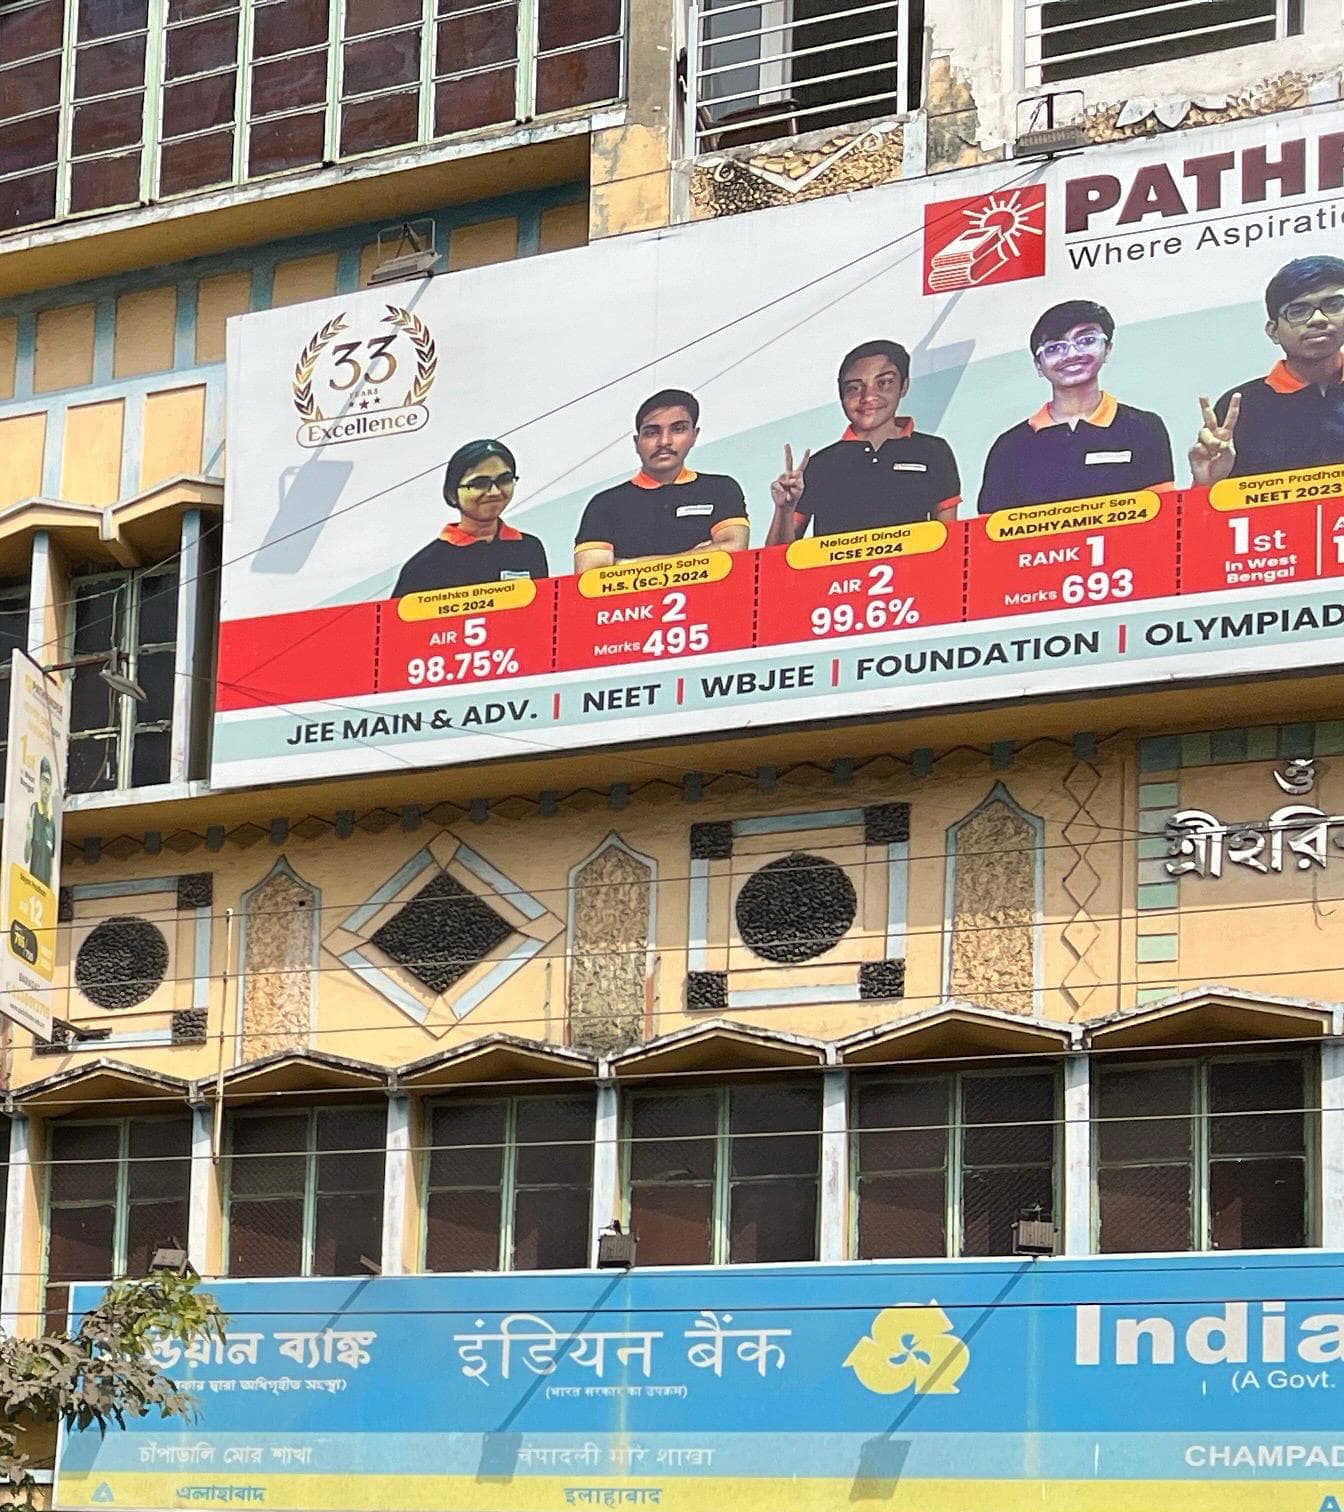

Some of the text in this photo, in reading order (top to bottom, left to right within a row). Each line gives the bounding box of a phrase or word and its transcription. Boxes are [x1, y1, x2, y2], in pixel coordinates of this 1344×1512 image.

[1068, 239, 1182, 271] Where
[329, 334, 397, 391] 33
[308, 412, 418, 442] Excellence
[1239, 478, 1284, 490] Sayan
[1245, 483, 1342, 504] NEET 2023
[1007, 496, 1137, 522] Chandrachur Sen
[871, 527, 911, 542] Dinda
[999, 509, 1148, 538] MADHYAMIK 2024
[1228, 517, 1287, 555] 1st
[830, 542, 903, 562] ICSE 2024
[1018, 536, 1105, 568] RANK 1
[1248, 554, 1297, 570] West
[599, 557, 710, 581] Soumyadip Saha
[602, 569, 708, 593] H.S. (SC.) 2024
[829, 564, 894, 596] AIR 2
[1227, 566, 1295, 584] Bengal
[417, 583, 515, 604] Tanishka Bhowal
[1004, 568, 1134, 608] Marks 693
[438, 598, 494, 615] ISC 2024
[597, 592, 687, 625] RANK 2
[811, 597, 920, 635] 99.6%
[429, 617, 487, 646] AIR 5
[594, 624, 709, 657] Marks 495
[407, 648, 520, 685] 98.75%
[287, 631, 1100, 746] JEE MAIN ADV. NEET WBJEE FOUNDATION
[454, 1310, 792, 1386] इंडियन बैंक
[1268, 1370, 1336, 1388] Govt.
[224, 1445, 312, 1465] মোর শাখা
[657, 1447, 715, 1466] शाखा
[176, 1486, 266, 1502] এলাহাবাদ
